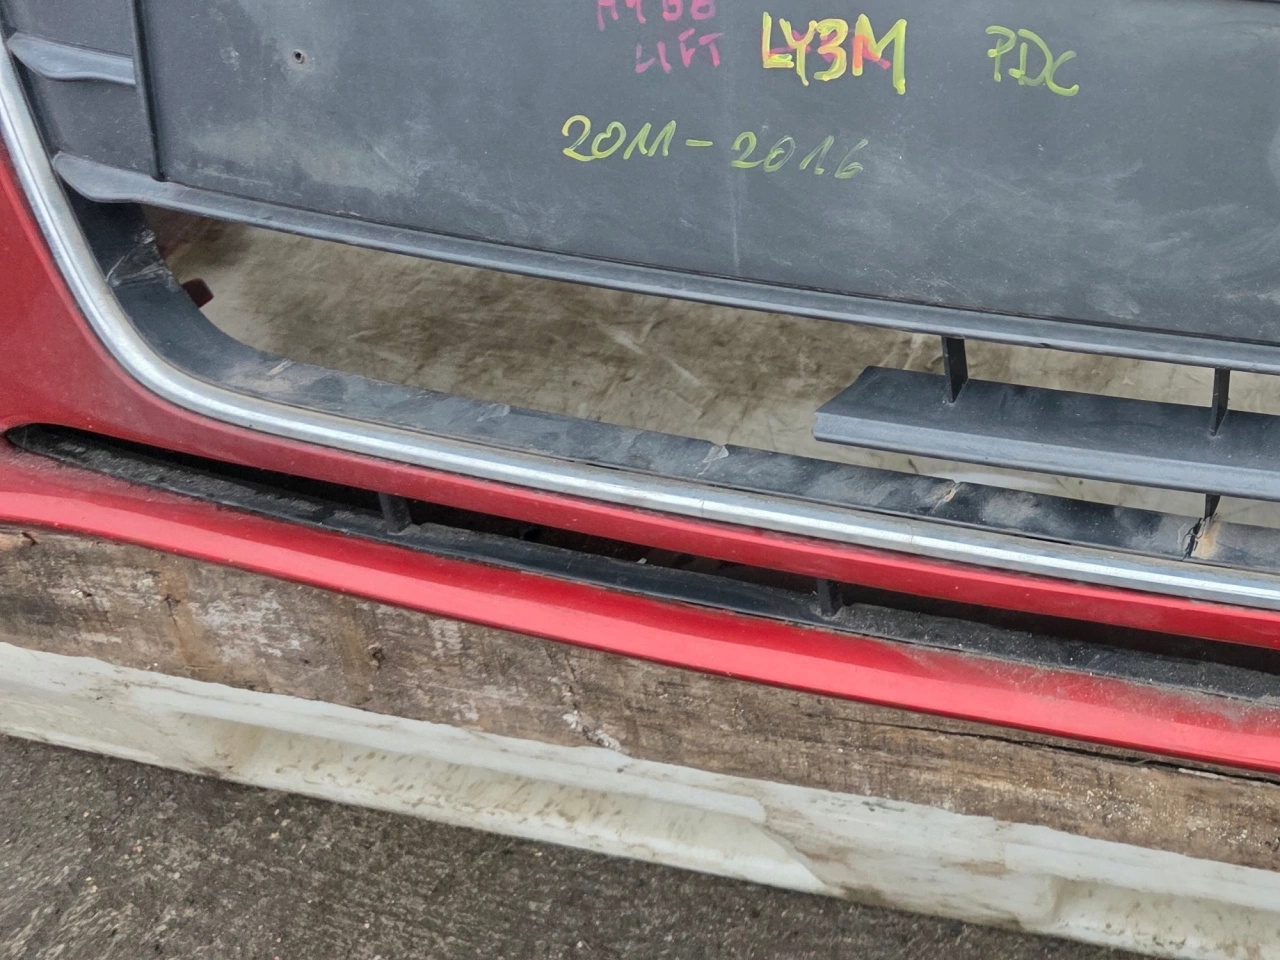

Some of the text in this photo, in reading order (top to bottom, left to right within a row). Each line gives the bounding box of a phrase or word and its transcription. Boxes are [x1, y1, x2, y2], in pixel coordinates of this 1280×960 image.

[634, 28, 724, 73] LIFT
[761, 12, 907, 95] LY3M
[985, 25, 1079, 96] PDC
